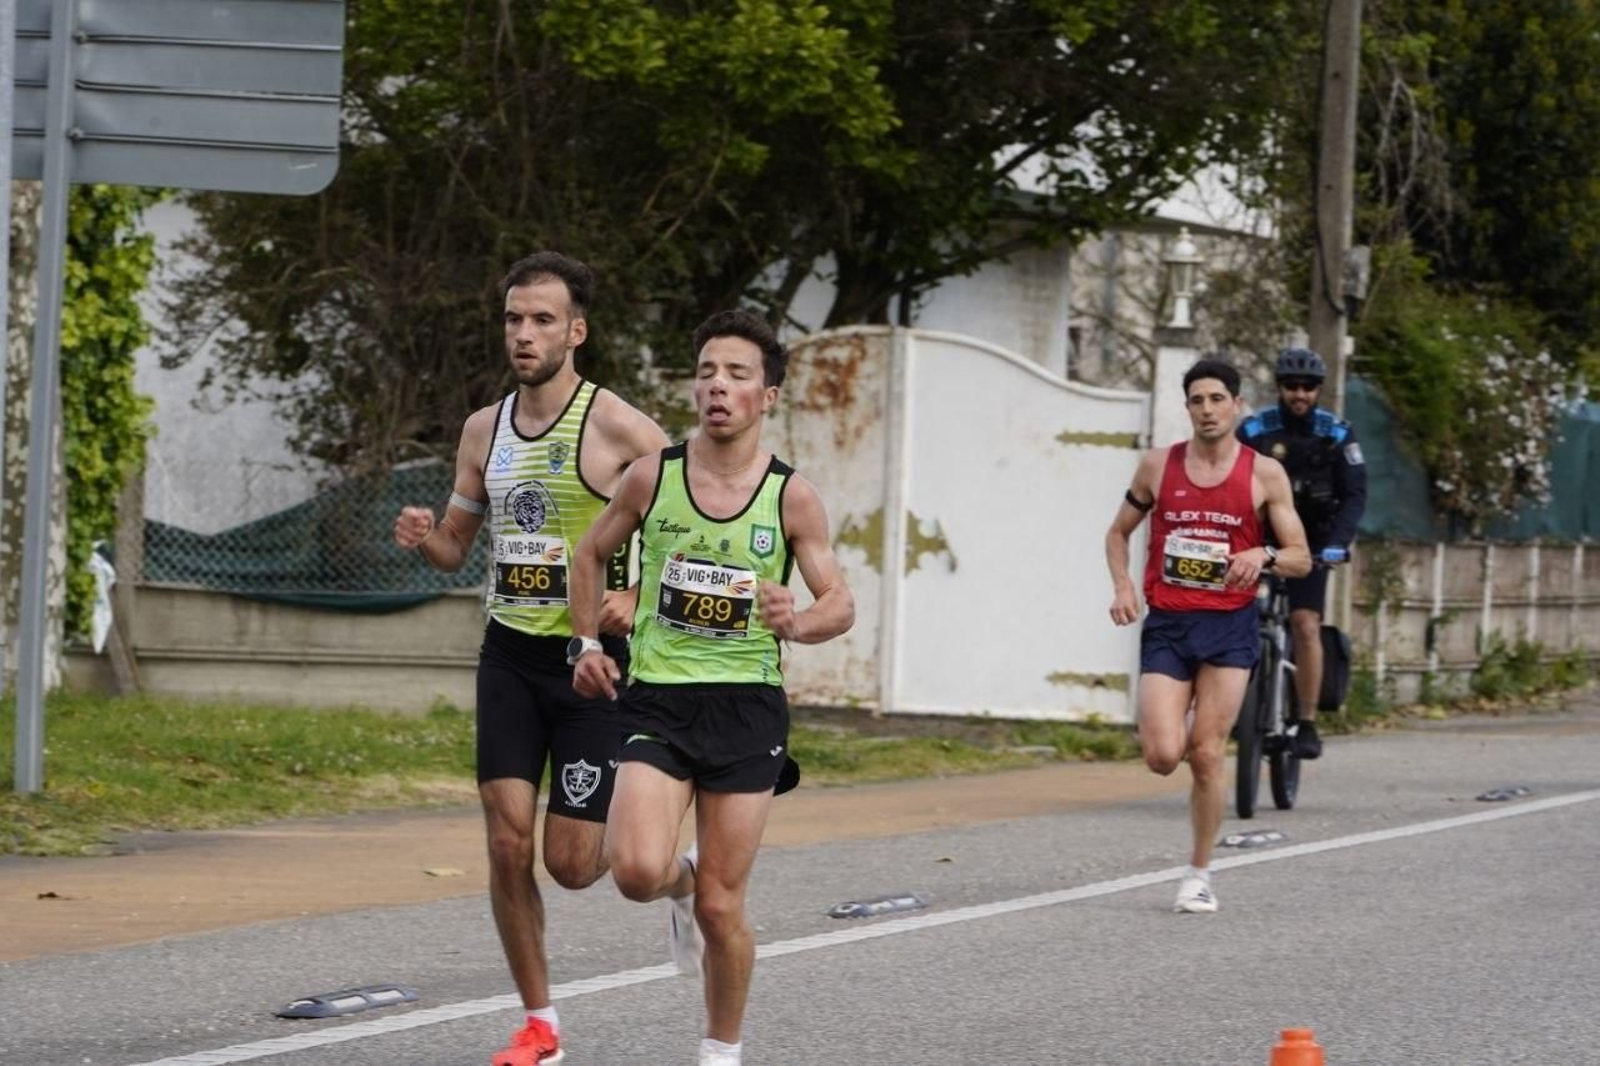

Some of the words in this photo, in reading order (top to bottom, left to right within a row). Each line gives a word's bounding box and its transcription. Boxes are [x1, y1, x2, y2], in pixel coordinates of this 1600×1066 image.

[1164, 510, 1200, 522] ALEX
[1204, 511, 1242, 526] TEAM
[508, 566, 550, 590] 456
[668, 568, 680, 581] 25
[1178, 559, 1212, 578] 652
[682, 593, 732, 621] 789
